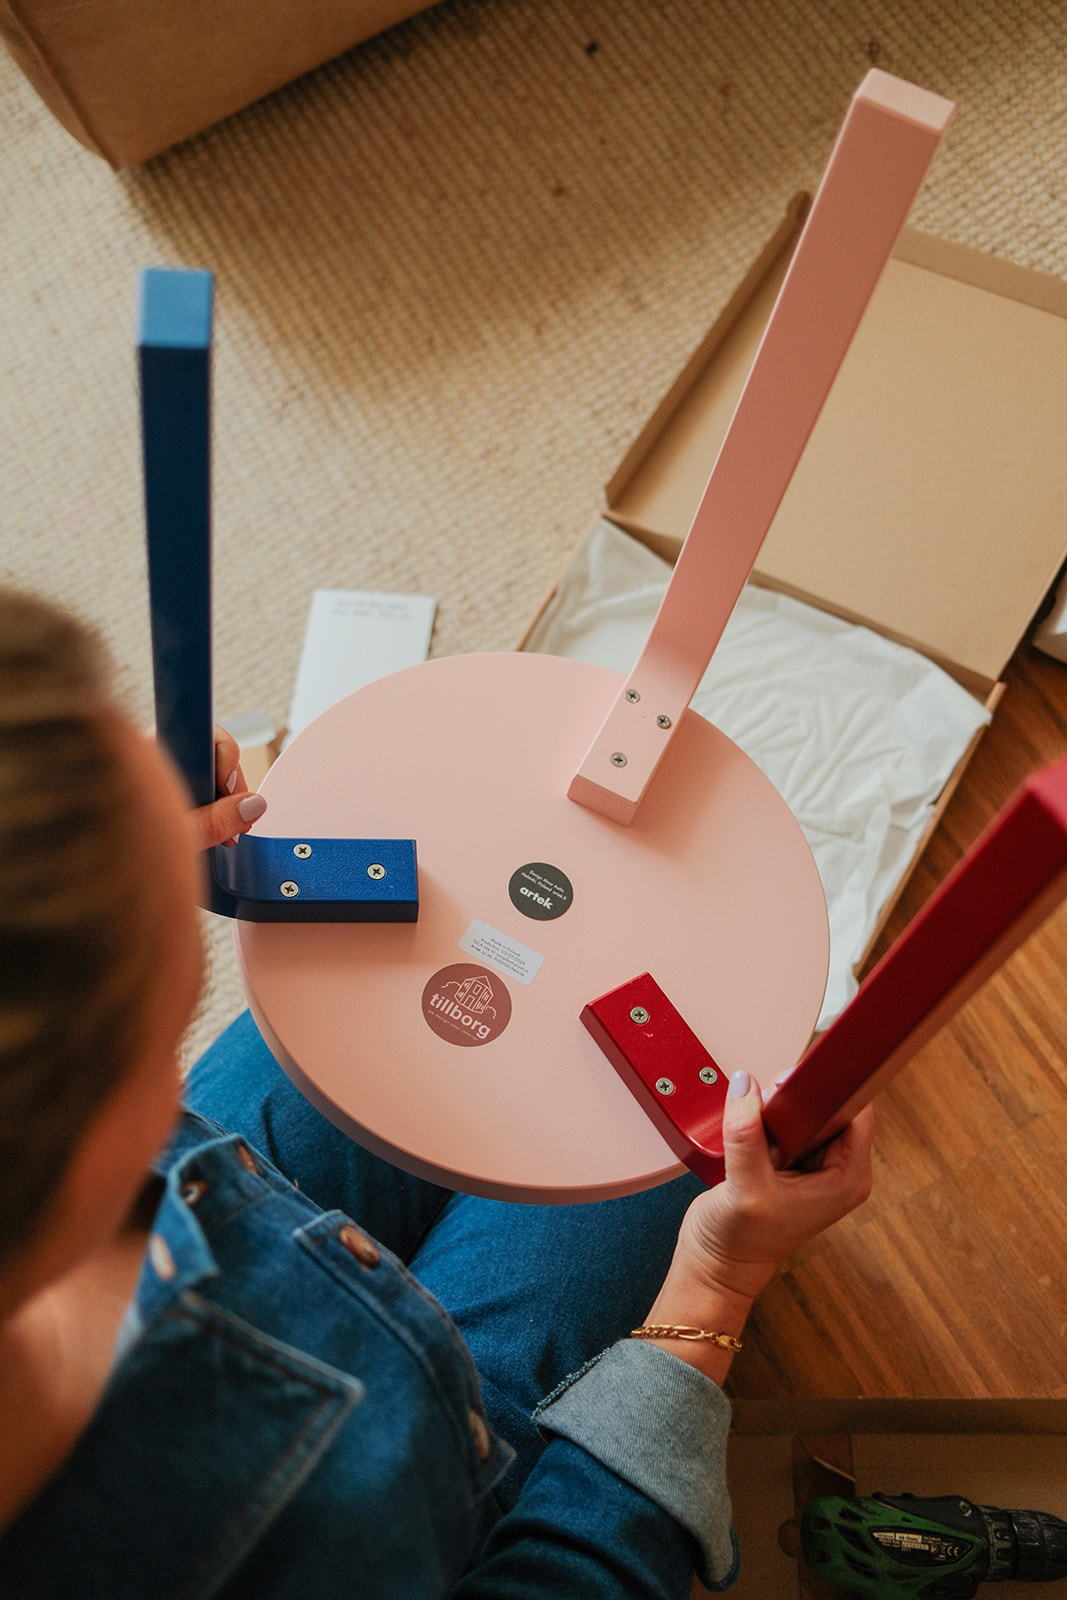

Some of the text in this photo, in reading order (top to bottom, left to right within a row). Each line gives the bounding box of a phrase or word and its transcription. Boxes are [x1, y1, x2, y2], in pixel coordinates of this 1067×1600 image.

[520, 887, 553, 910] artek
[430, 993, 491, 1039] tillborg
[435, 1014, 450, 1024] design
